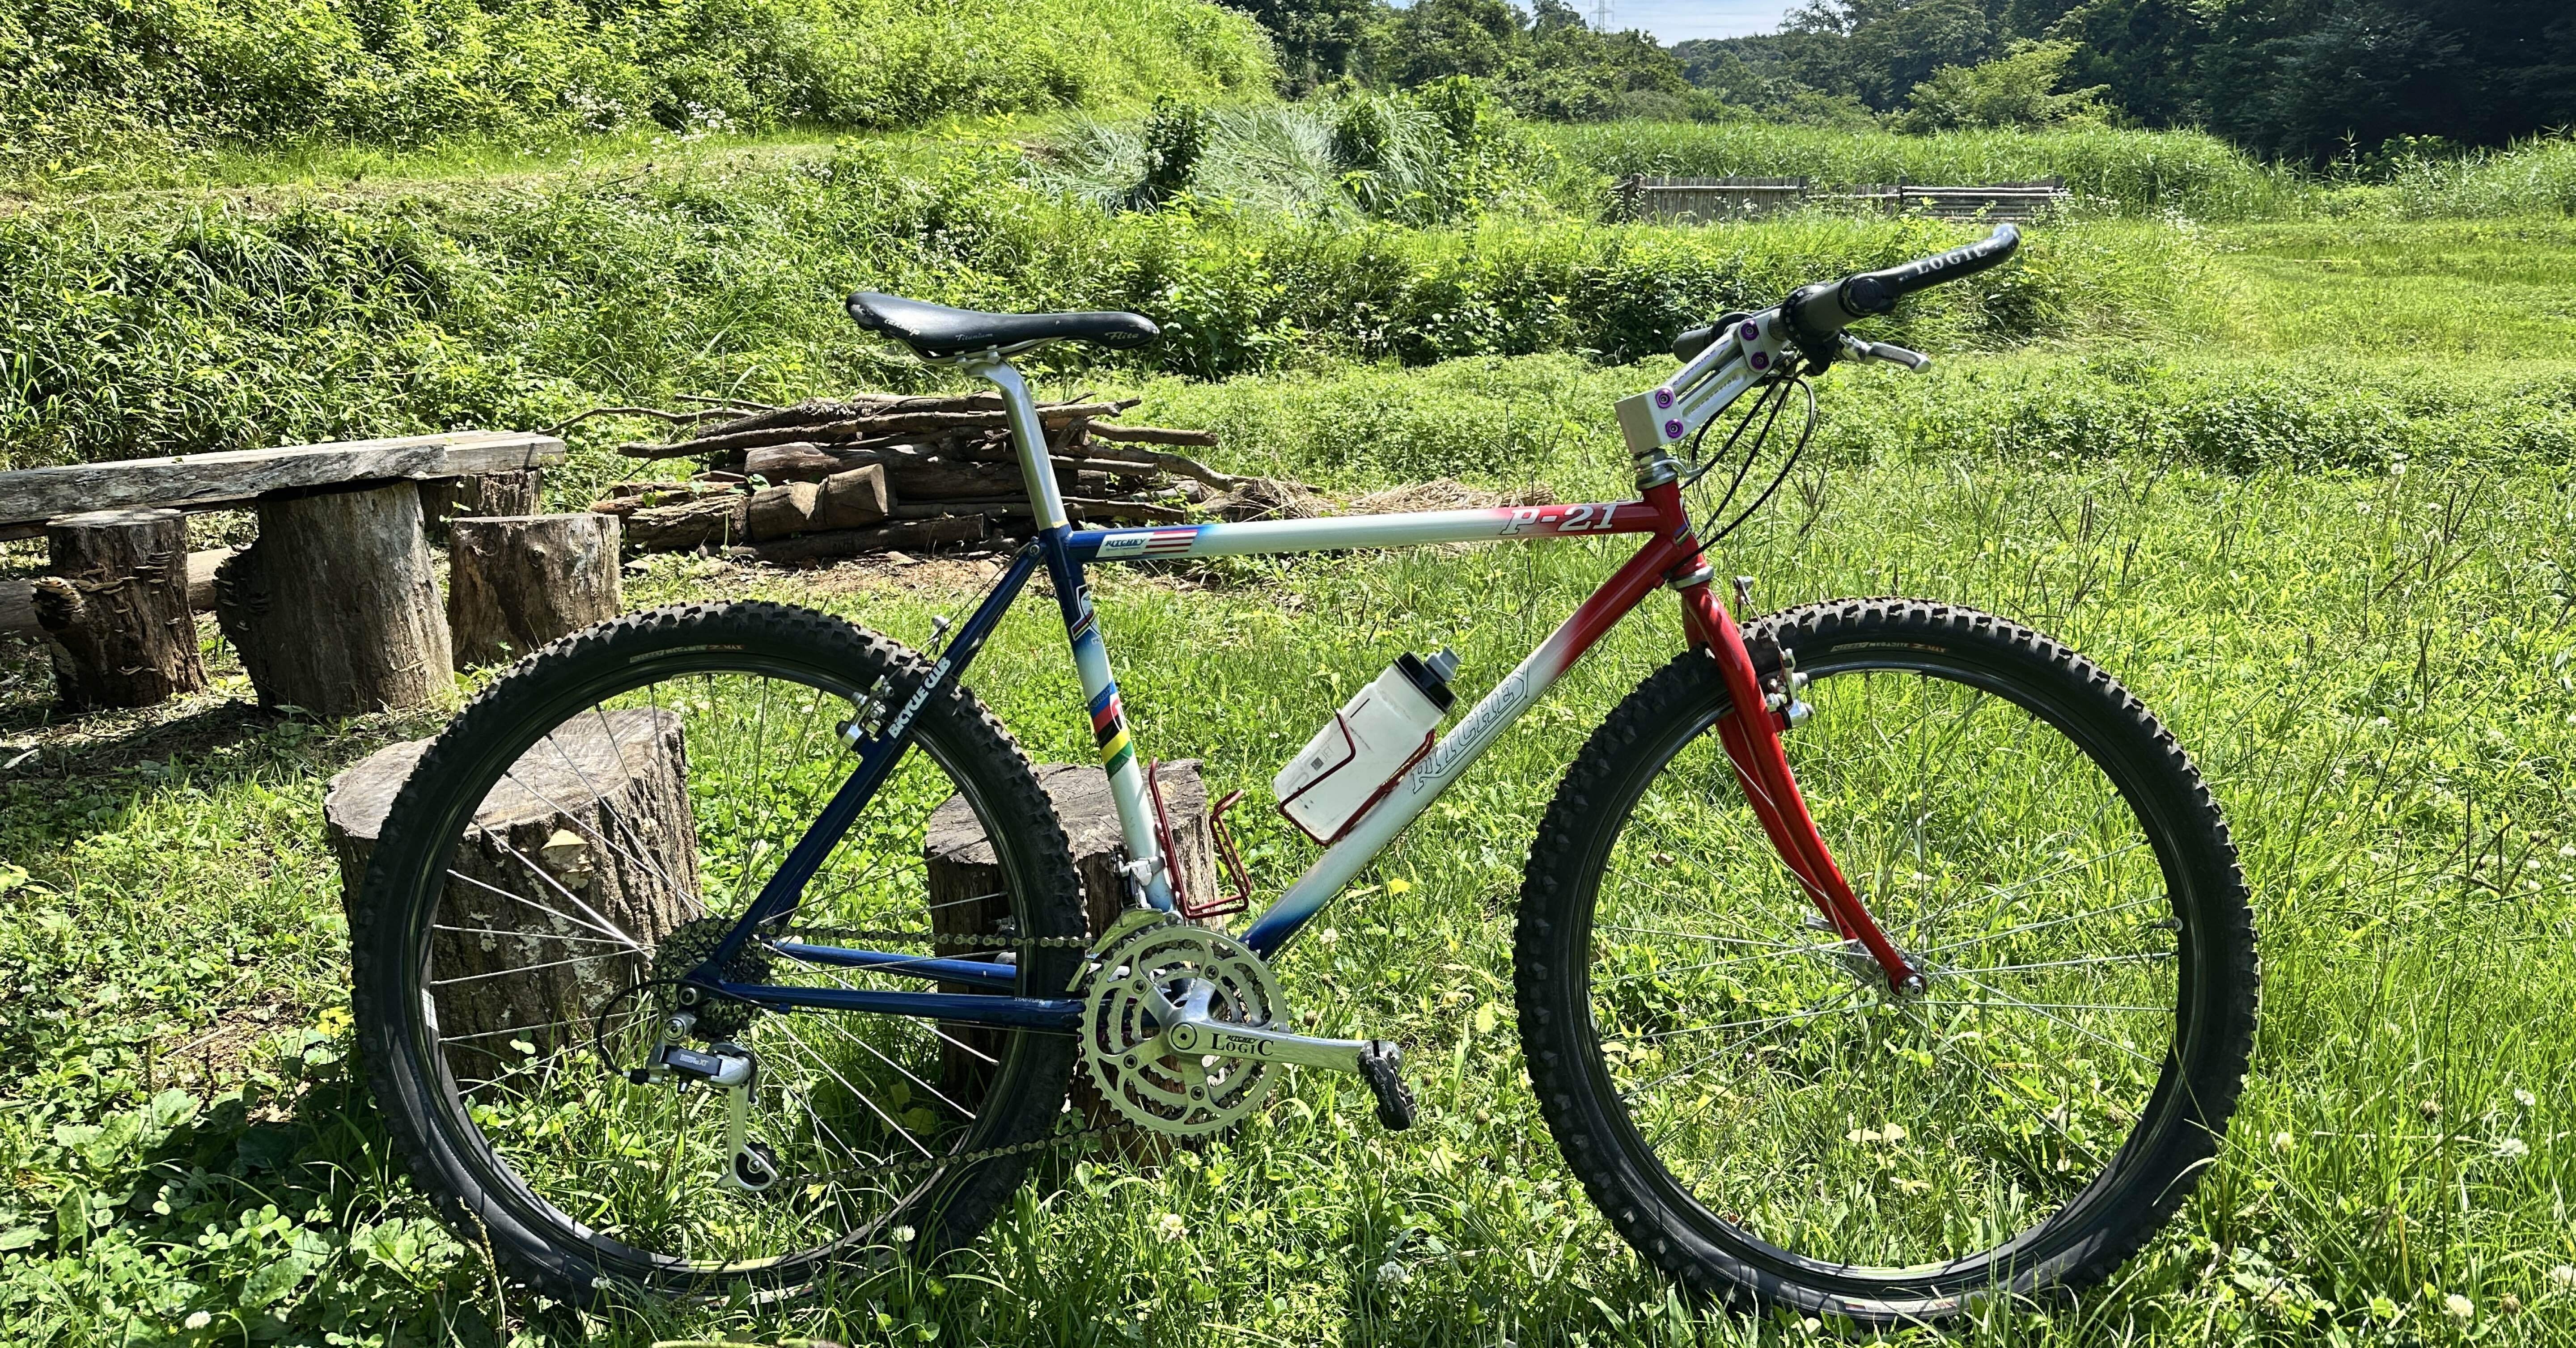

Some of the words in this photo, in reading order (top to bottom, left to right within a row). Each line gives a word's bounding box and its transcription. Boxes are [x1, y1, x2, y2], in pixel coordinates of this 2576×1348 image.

[1916, 245, 1987, 275] LOGIC
[1105, 331, 1139, 340] Flite
[1499, 503, 1620, 535] P-21
[1105, 538, 1147, 547] RITCHEY
[924, 657, 951, 689] CLUB
[1411, 656, 1533, 794] RITCHEY
[1210, 1033, 1274, 1056] LOGIC
[1225, 1035, 1259, 1044] RITCHEY
